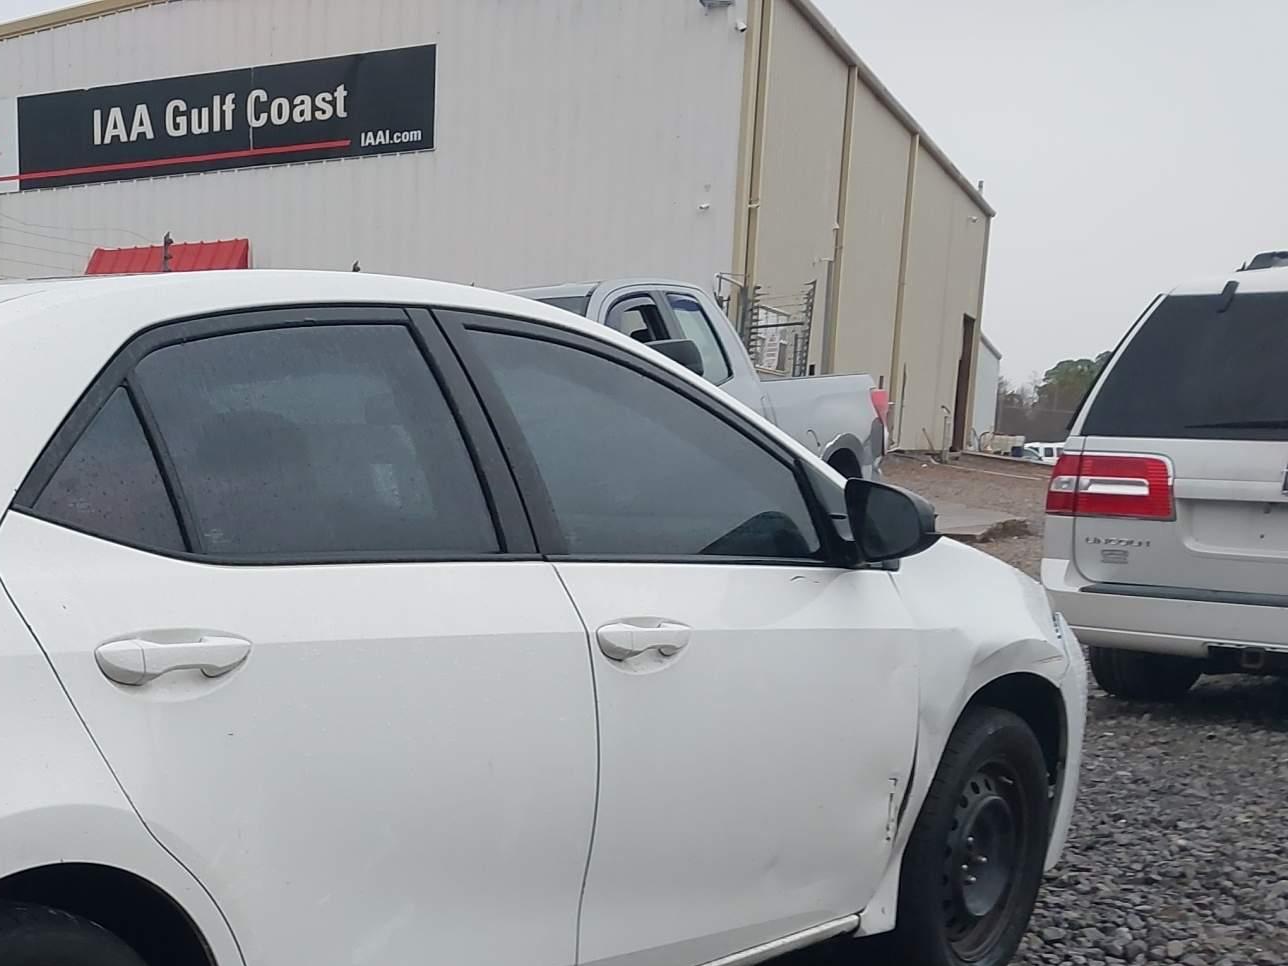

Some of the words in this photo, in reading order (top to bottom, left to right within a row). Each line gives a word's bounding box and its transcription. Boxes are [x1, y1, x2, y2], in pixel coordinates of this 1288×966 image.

[93, 103, 155, 146] IAA
[165, 92, 236, 138] Gulf
[246, 83, 349, 129] Coast
[360, 128, 423, 148] IAAI.com
